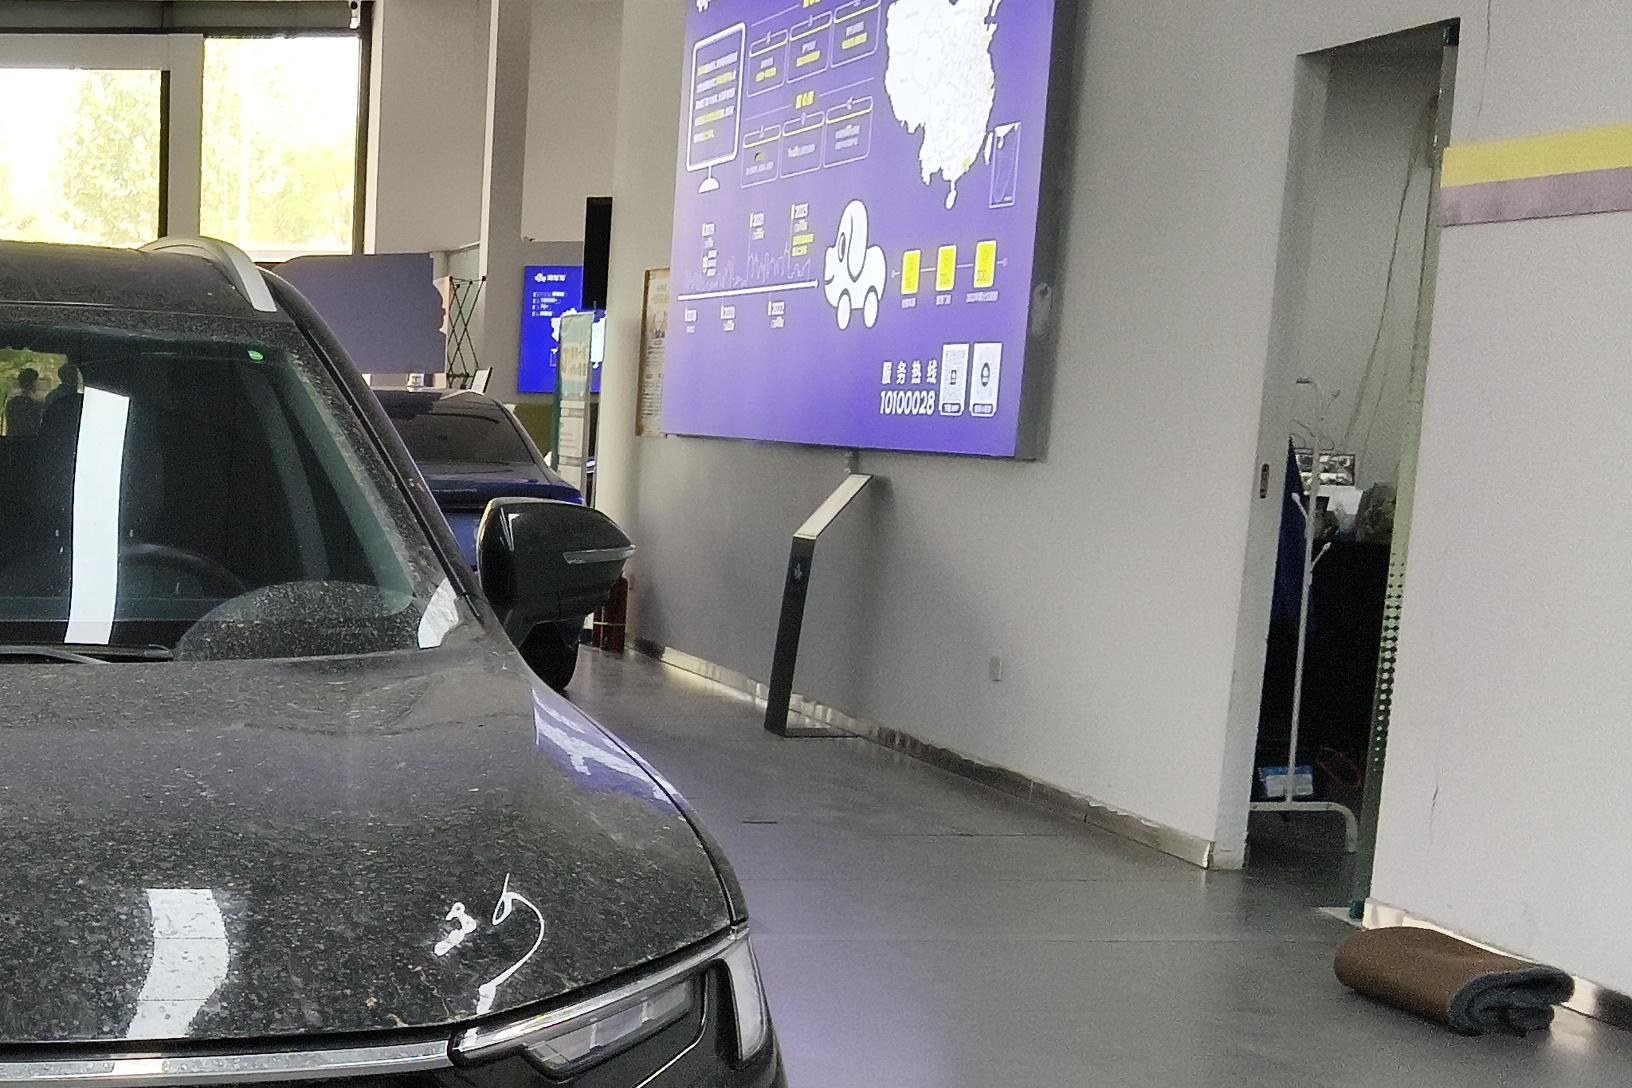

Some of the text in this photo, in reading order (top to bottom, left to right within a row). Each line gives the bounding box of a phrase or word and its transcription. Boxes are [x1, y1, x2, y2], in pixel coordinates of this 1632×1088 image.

[881, 360, 938, 384] 服务热线
[880, 390, 936, 415] 10100028
